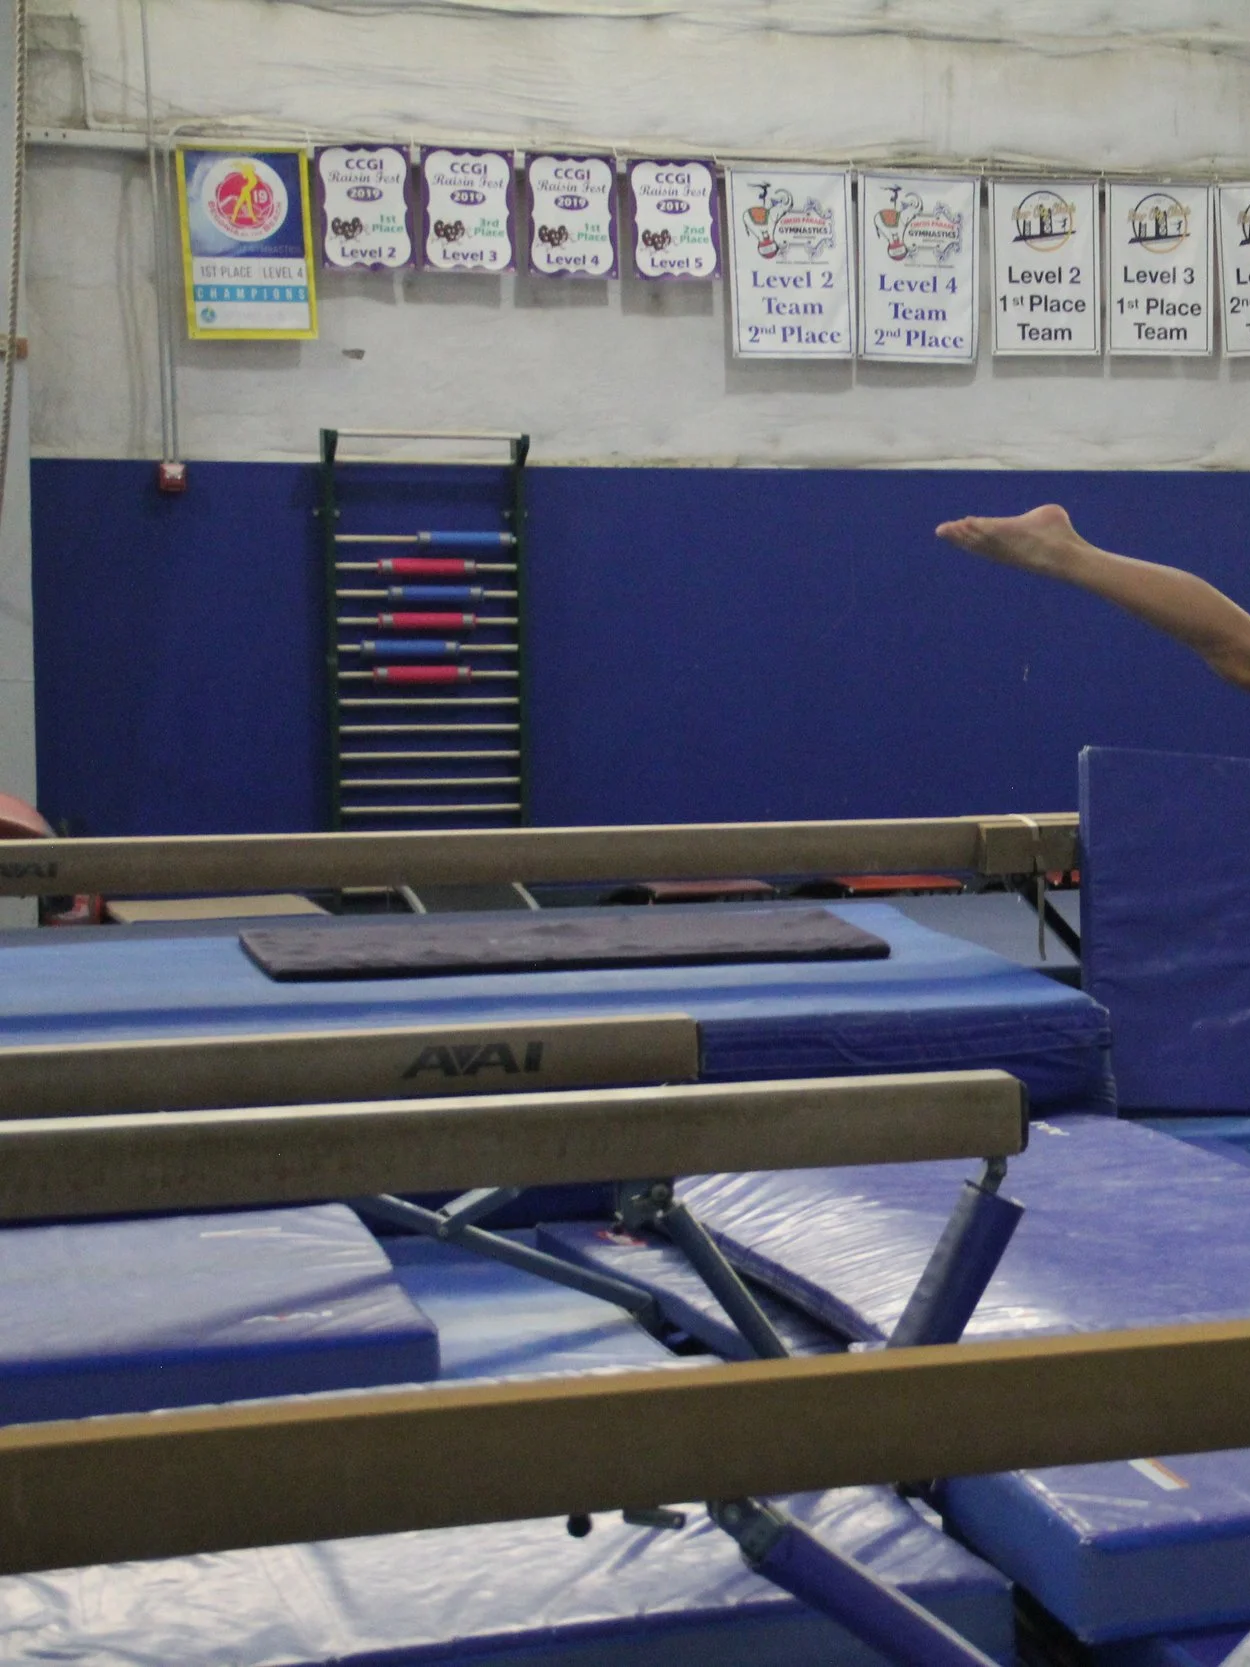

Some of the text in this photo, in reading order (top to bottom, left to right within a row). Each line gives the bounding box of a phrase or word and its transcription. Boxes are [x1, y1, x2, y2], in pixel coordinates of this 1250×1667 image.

[345, 158, 384, 170] CCGI
[450, 162, 488, 175] CCGI
[328, 171, 401, 185] Raisin Fest
[554, 168, 591, 181] CCGI
[655, 172, 691, 185] CCGI
[432, 174, 505, 189] Raisin Fest
[537, 180, 607, 195] Raisin Fest
[253, 189, 268, 203] 19
[349, 188, 380, 200] 2019
[453, 191, 484, 203] 2019
[639, 184, 707, 198] Raisin Fest
[557, 197, 587, 208] 2019
[659, 201, 687, 212] 2019
[380, 214, 396, 224] 1st
[480, 218, 500, 229] 3rd
[372, 223, 404, 234] Place
[474, 228, 505, 238] Place
[584, 223, 601, 233] 1st
[683, 225, 705, 234] 2nd
[779, 226, 829, 235] GYMNASTICS
[908, 230, 957, 239] GYMNASTICS
[577, 232, 607, 242] Place
[679, 234, 709, 244] Place
[341, 247, 397, 259] Level 2
[443, 249, 498, 262] Level 3
[546, 253, 600, 266] Level 4
[651, 258, 703, 269] Level 5
[201, 266, 252, 278] 1ST PLACE
[263, 266, 304, 279] LEVEL 4
[1007, 267, 1081, 284] Level 2
[1123, 266, 1195, 284] Level 3
[751, 271, 834, 289] Level 2
[878, 274, 959, 294] Level 4
[197, 287, 306, 300] CHAMPIONS
[762, 296, 824, 315] Team
[999, 295, 1086, 312] 1st Place
[1116, 298, 1202, 316] 1st Place
[888, 301, 947, 321] Team
[748, 324, 842, 344] 2nd Place
[874, 328, 965, 349] 2nd Place
[1017, 323, 1072, 341] Team
[1134, 323, 1188, 341] Team
